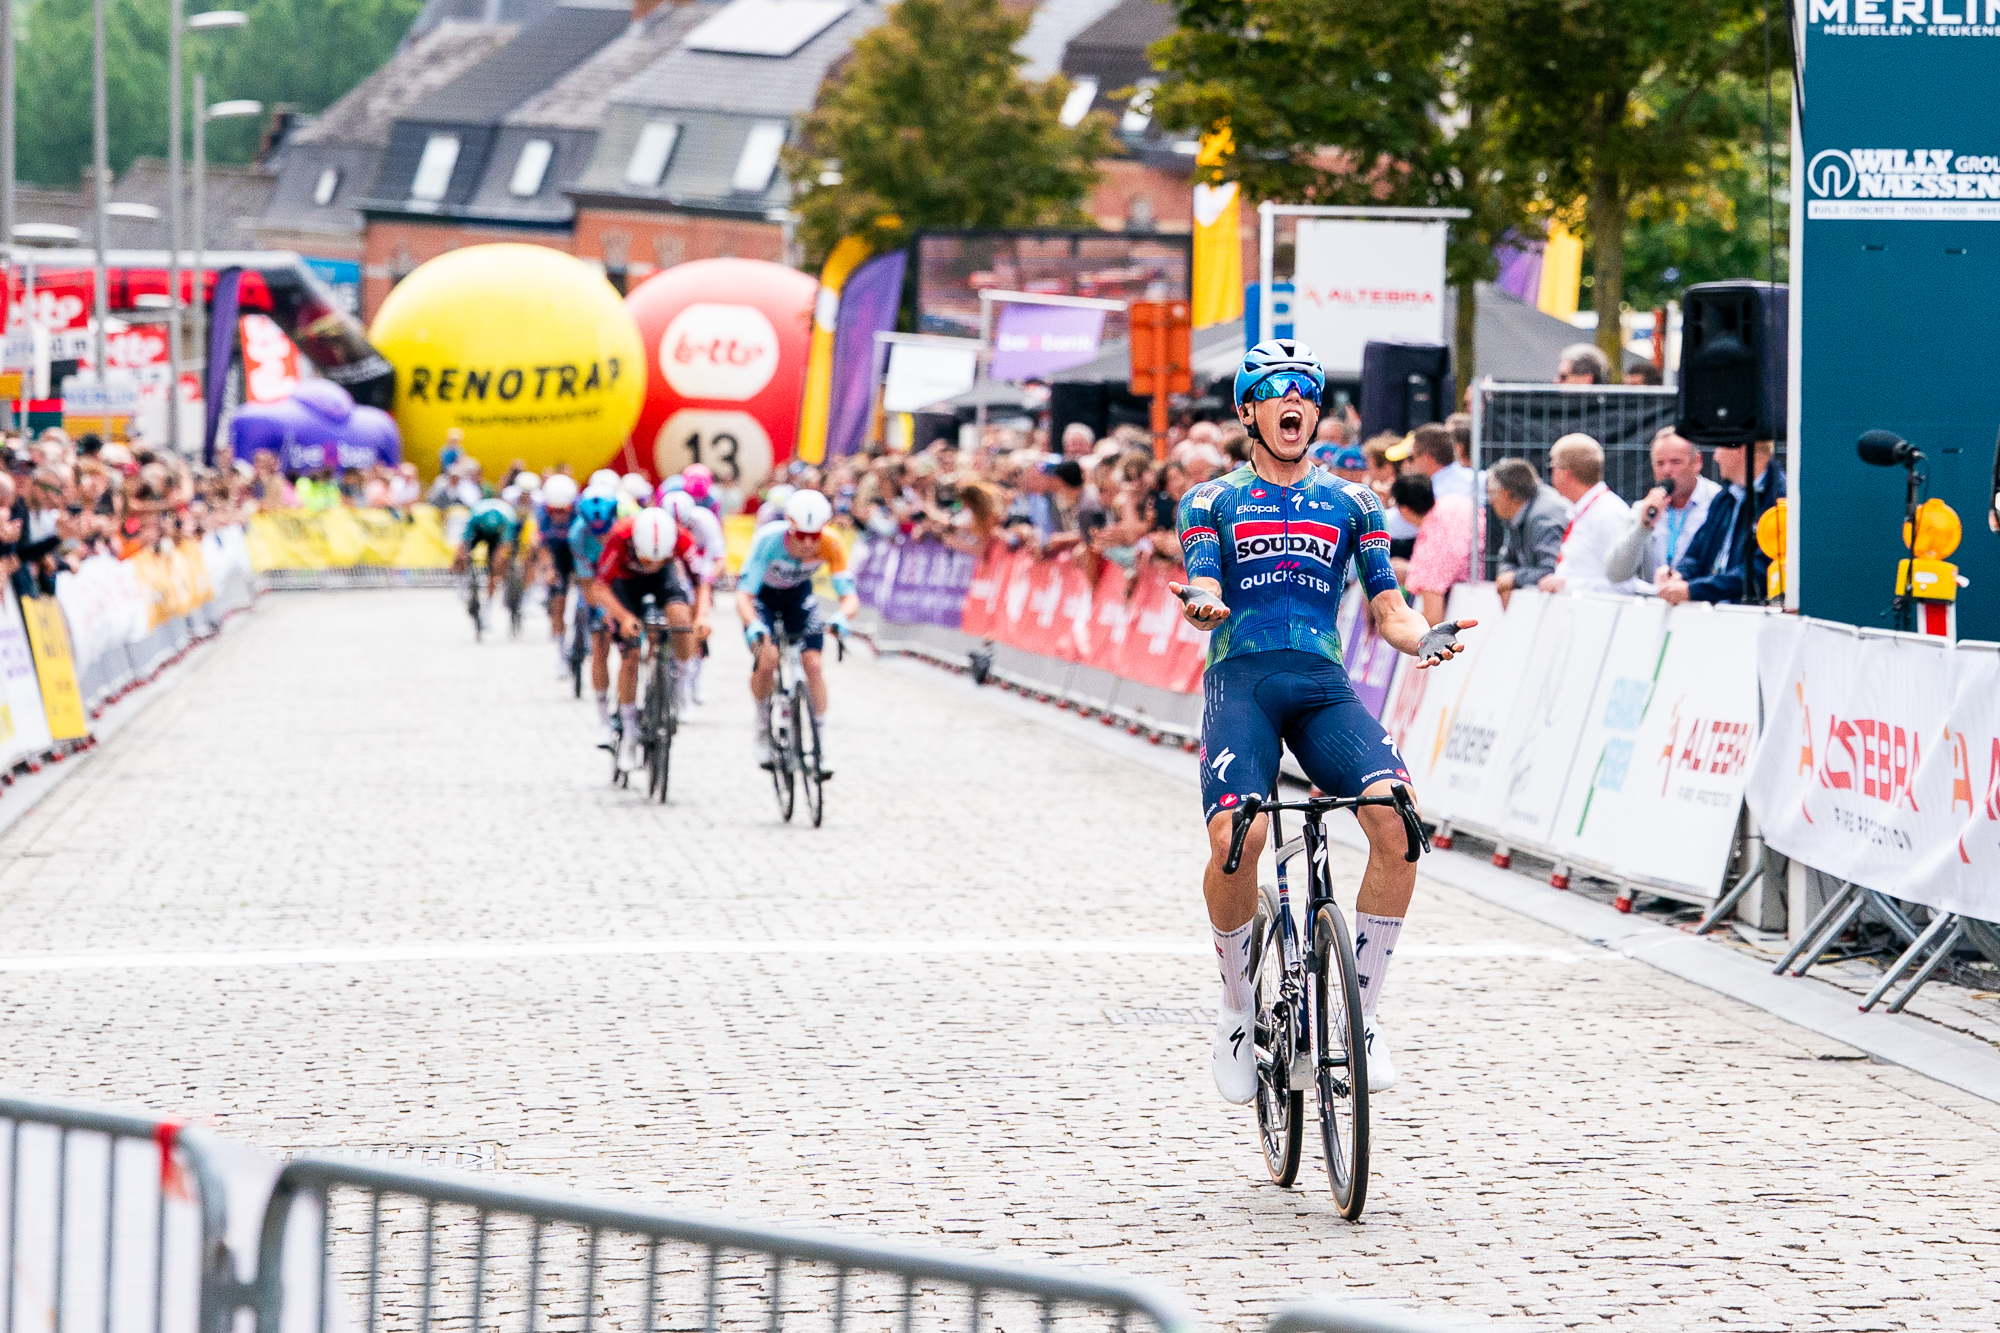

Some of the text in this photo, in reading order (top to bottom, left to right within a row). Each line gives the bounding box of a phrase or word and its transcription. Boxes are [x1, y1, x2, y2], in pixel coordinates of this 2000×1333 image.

[1823, 24, 1913, 36] MEUBELEN
[1850, 148, 1954, 174] WILLY
[1328, 288, 1435, 304] ALTEBRA
[683, 430, 741, 486] 13
[1235, 504, 1281, 515] Ekopak
[1236, 536, 1332, 564] SOUDAL
[1361, 767, 1394, 783] Ekopak
